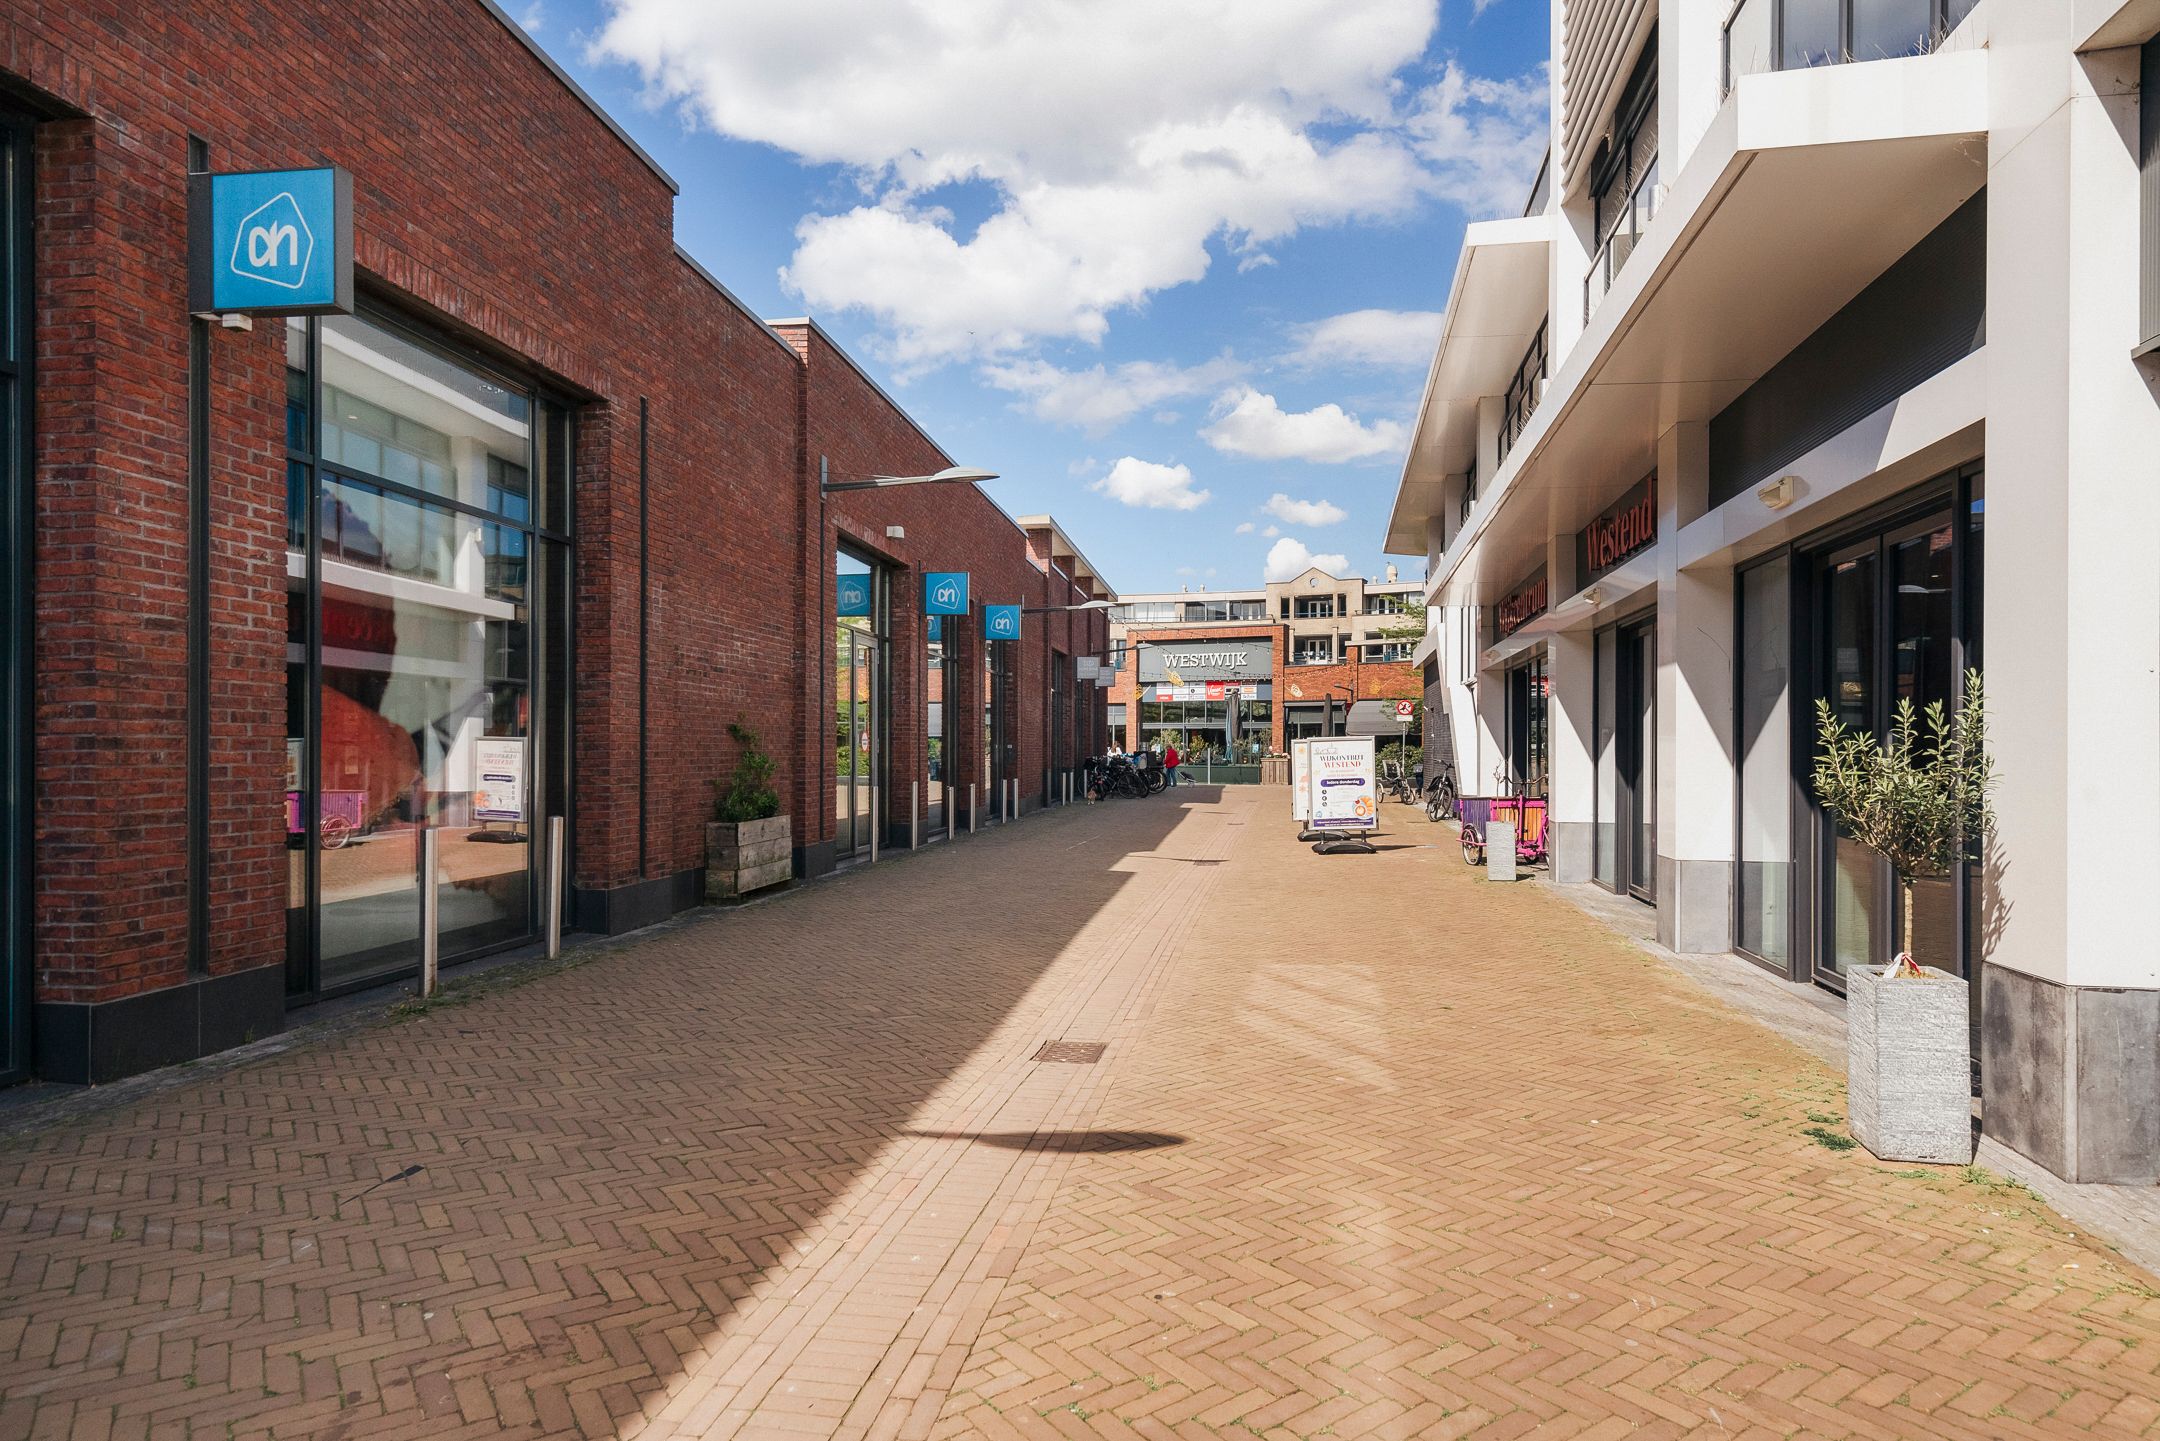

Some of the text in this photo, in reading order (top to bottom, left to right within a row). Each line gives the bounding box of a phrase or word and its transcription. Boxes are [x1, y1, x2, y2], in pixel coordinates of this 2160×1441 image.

[1585, 476, 1654, 576] Westend
[1163, 652, 1247, 669] WESTWIJK
[1324, 761, 1361, 769] WESTEND
